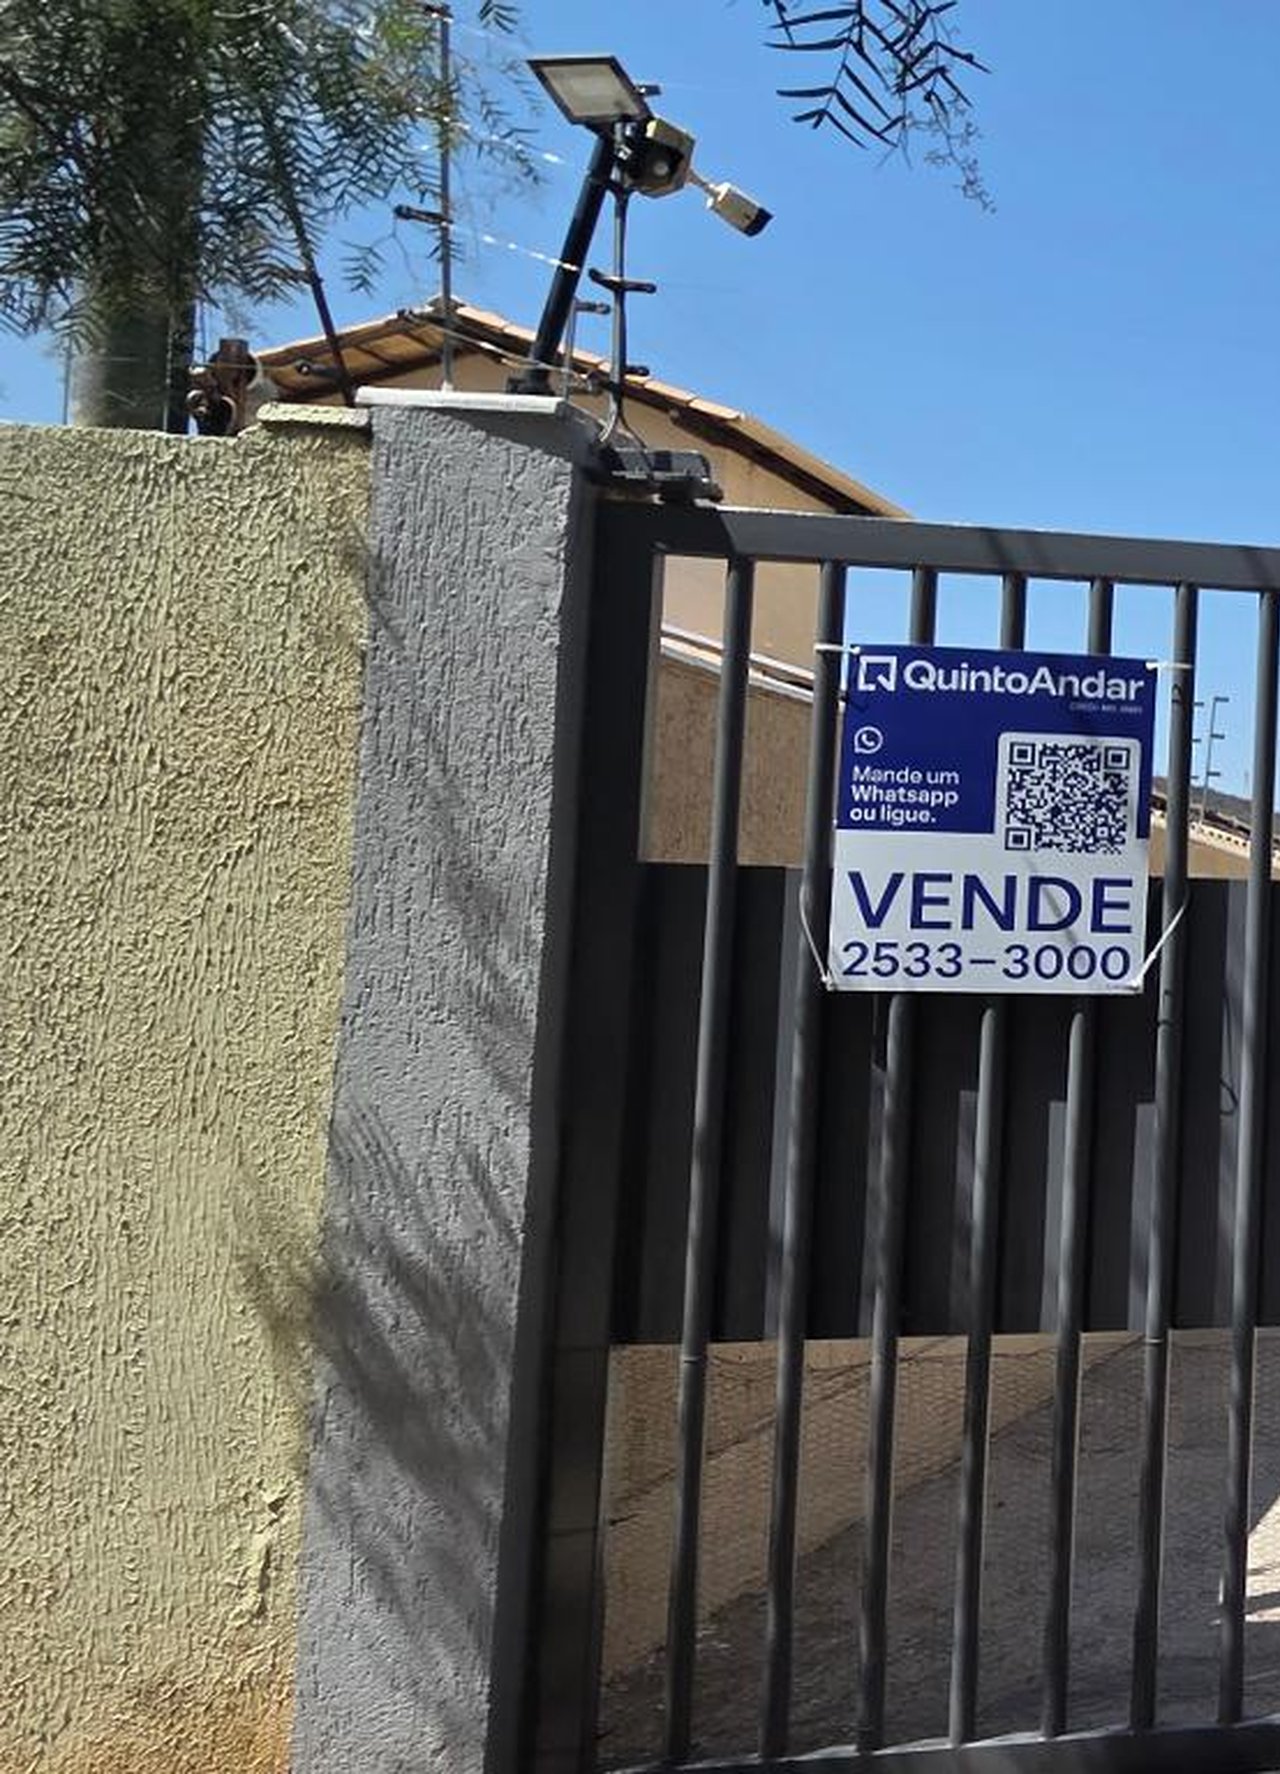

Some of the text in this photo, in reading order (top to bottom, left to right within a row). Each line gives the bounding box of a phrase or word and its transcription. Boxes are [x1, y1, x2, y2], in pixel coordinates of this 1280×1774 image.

[903, 658, 1145, 701] QuintoAndar
[852, 766, 960, 785] Mande um
[850, 783, 960, 807] Whatsapp
[849, 803, 937, 827] ou ligue.
[847, 871, 1134, 934] VENDE
[842, 940, 1132, 980] 2533-3000
